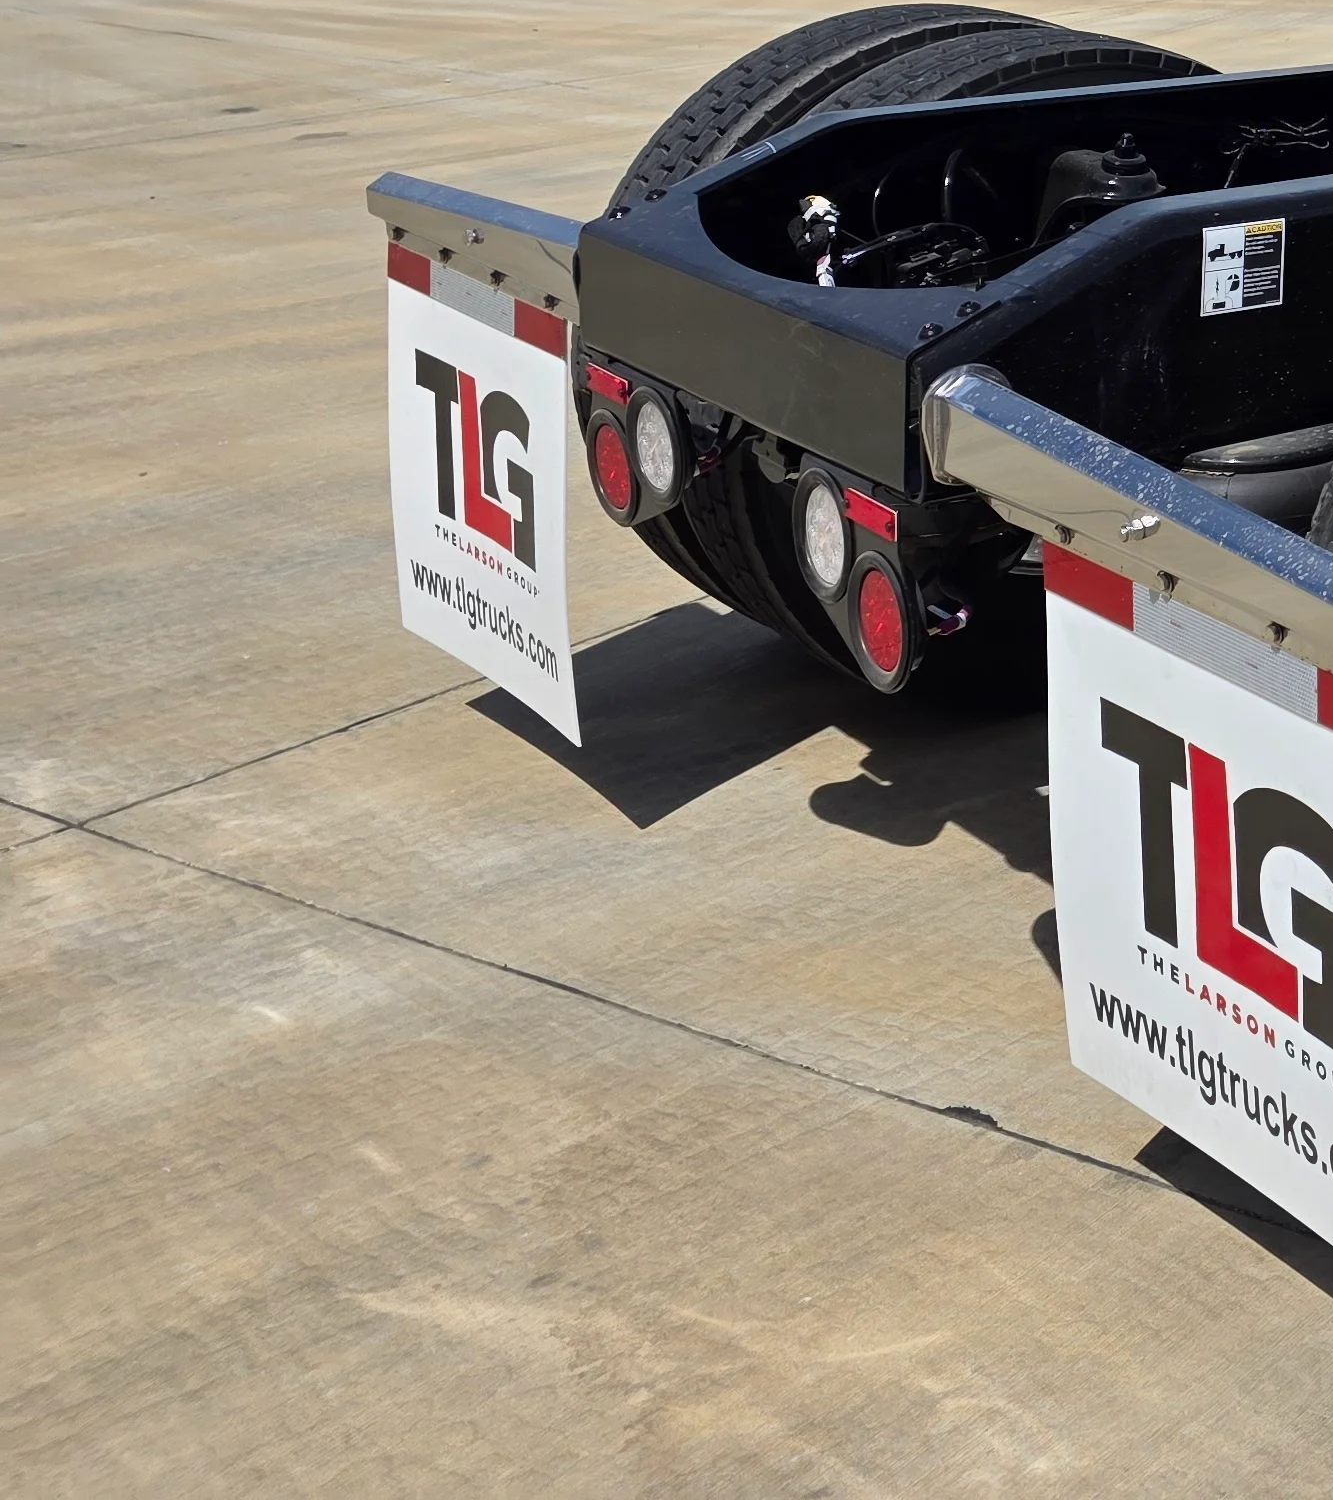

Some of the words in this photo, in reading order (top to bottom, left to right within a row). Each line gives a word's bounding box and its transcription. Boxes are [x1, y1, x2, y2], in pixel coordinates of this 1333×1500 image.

[1251, 223, 1282, 233] CAUTION
[414, 347, 537, 574] TLG
[410, 558, 559, 683] www.tlgtrucks.com
[506, 566, 538, 598] GROUP
[1137, 944, 1180, 985] THE
[1184, 972, 1276, 1049] LARSON
